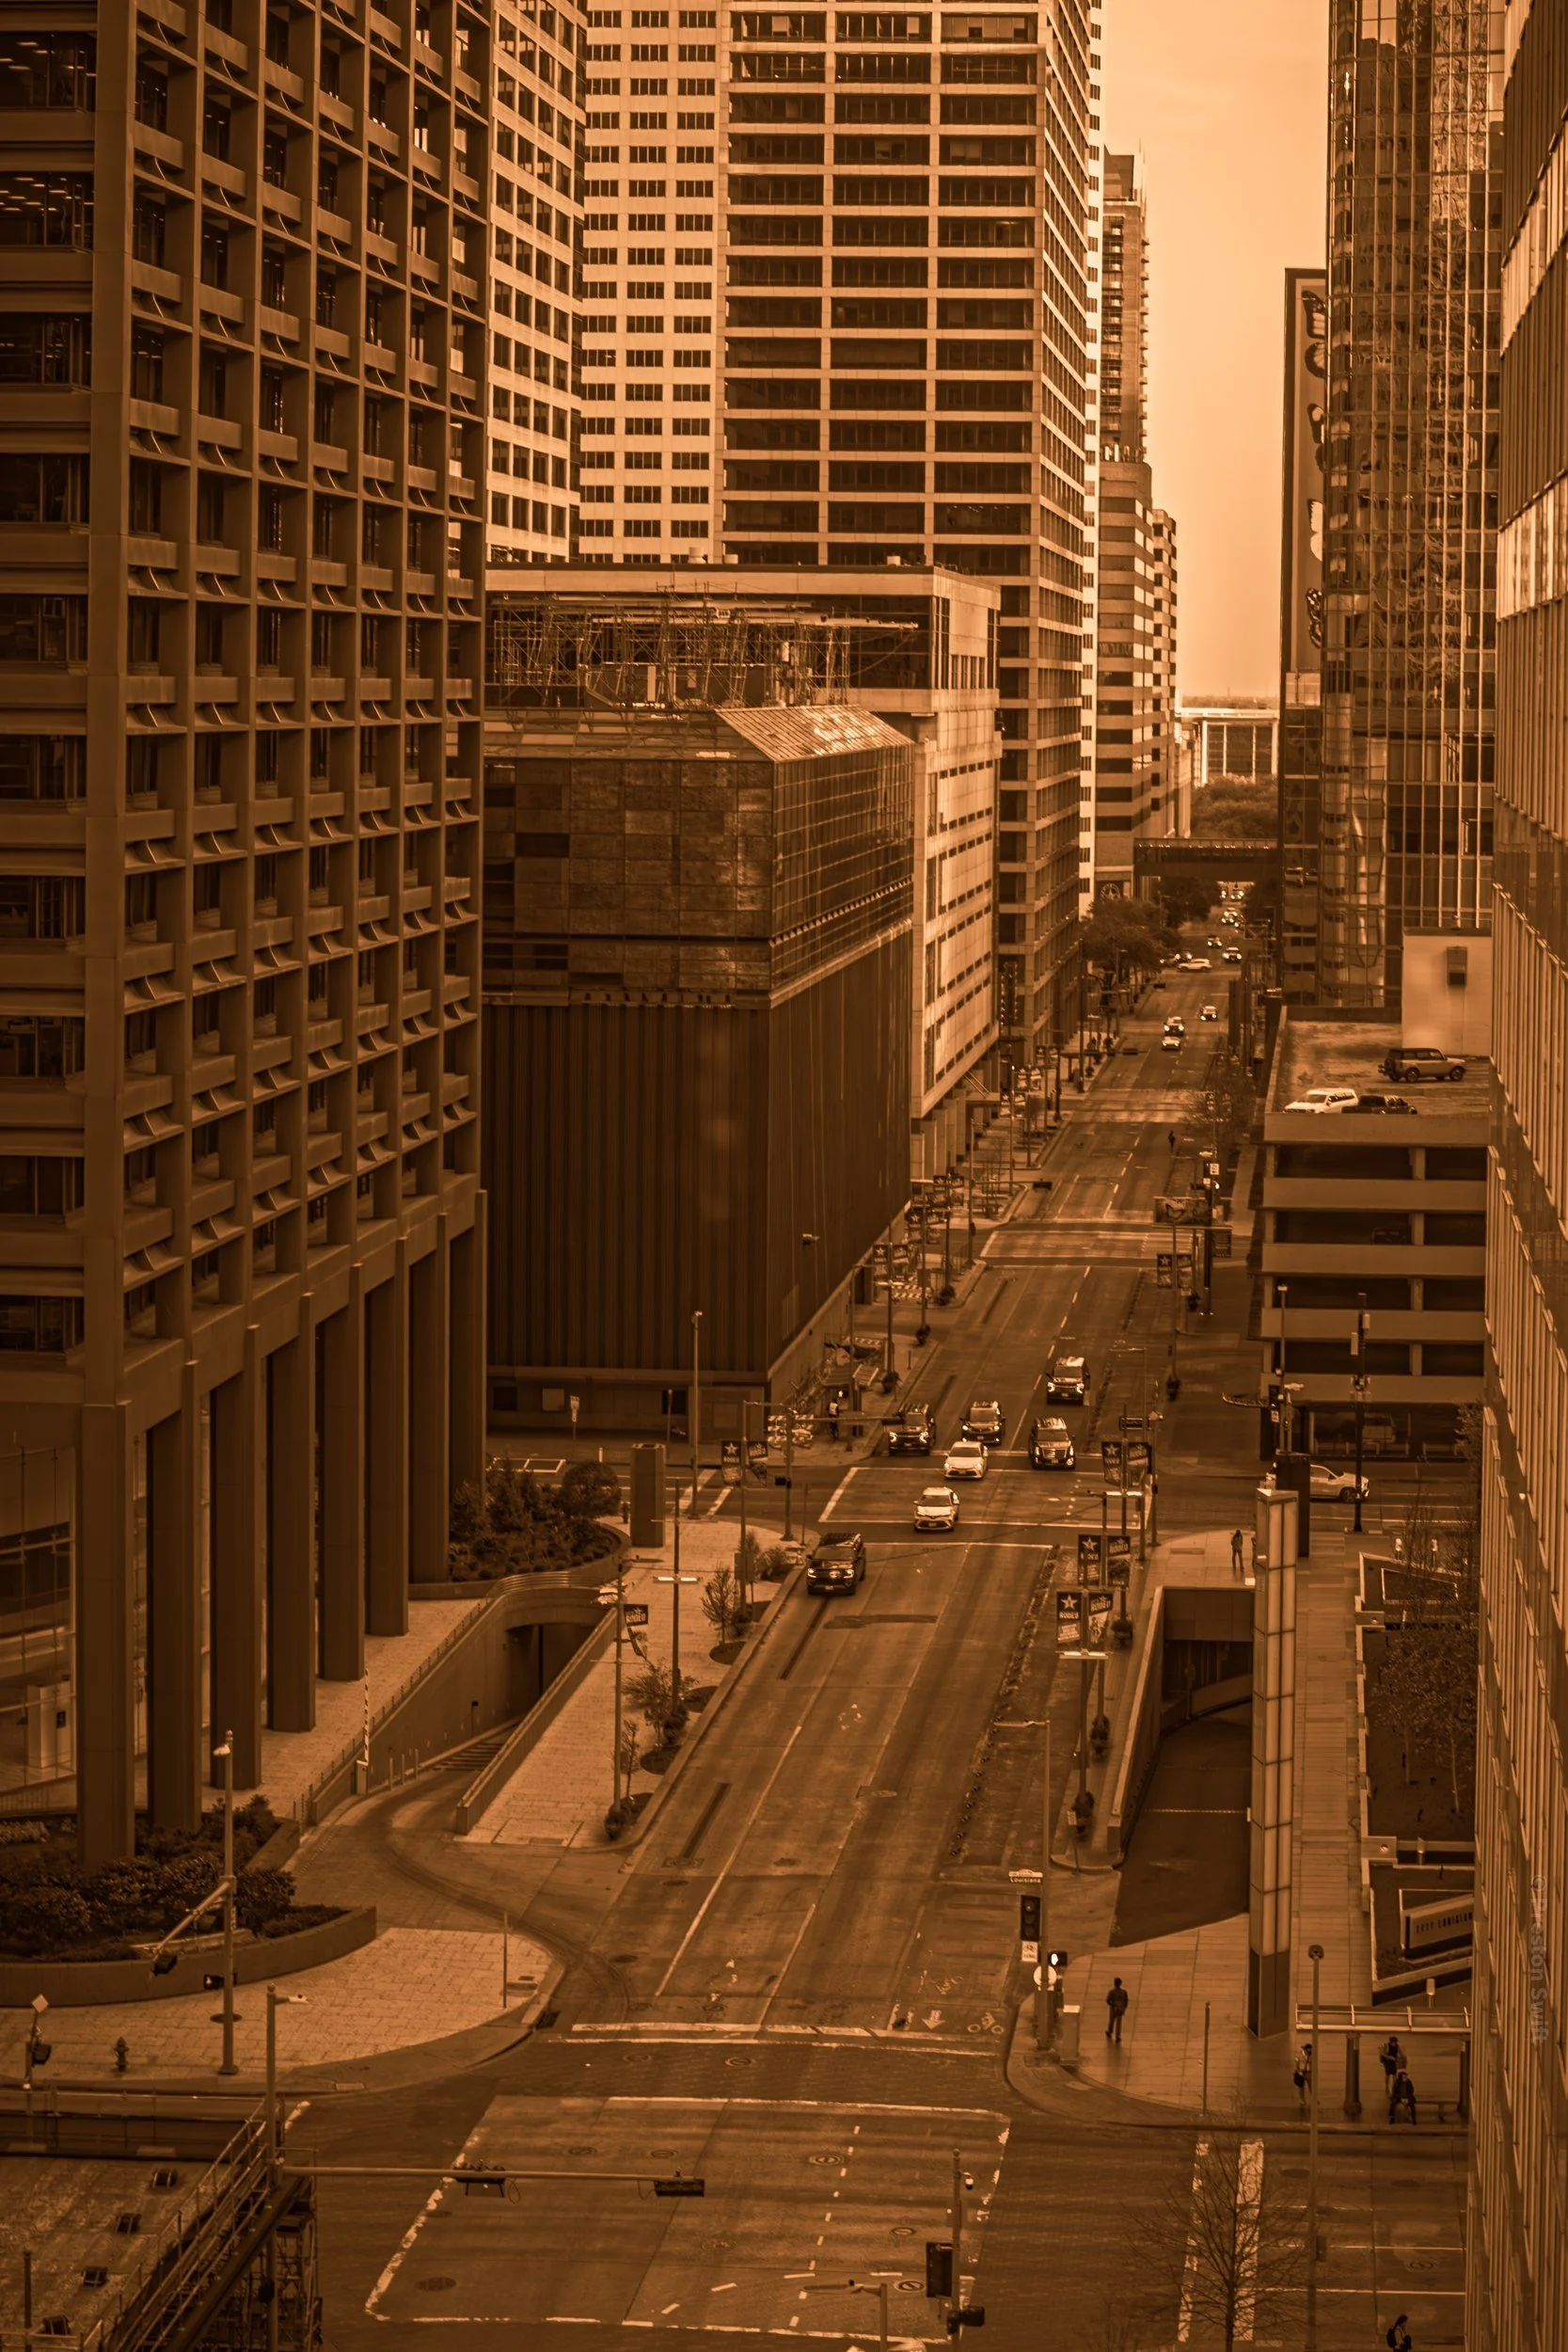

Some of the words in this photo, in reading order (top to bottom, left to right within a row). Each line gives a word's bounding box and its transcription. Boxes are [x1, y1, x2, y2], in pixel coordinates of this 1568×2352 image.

[1080, 1552, 1100, 1561] RDEO
[1090, 1600, 1111, 1612] RODEO
[626, 1613, 646, 1624] RODEO
[1059, 1611, 1079, 1619] RODEO
[1437, 1912, 1474, 1929] LOUISIAN
